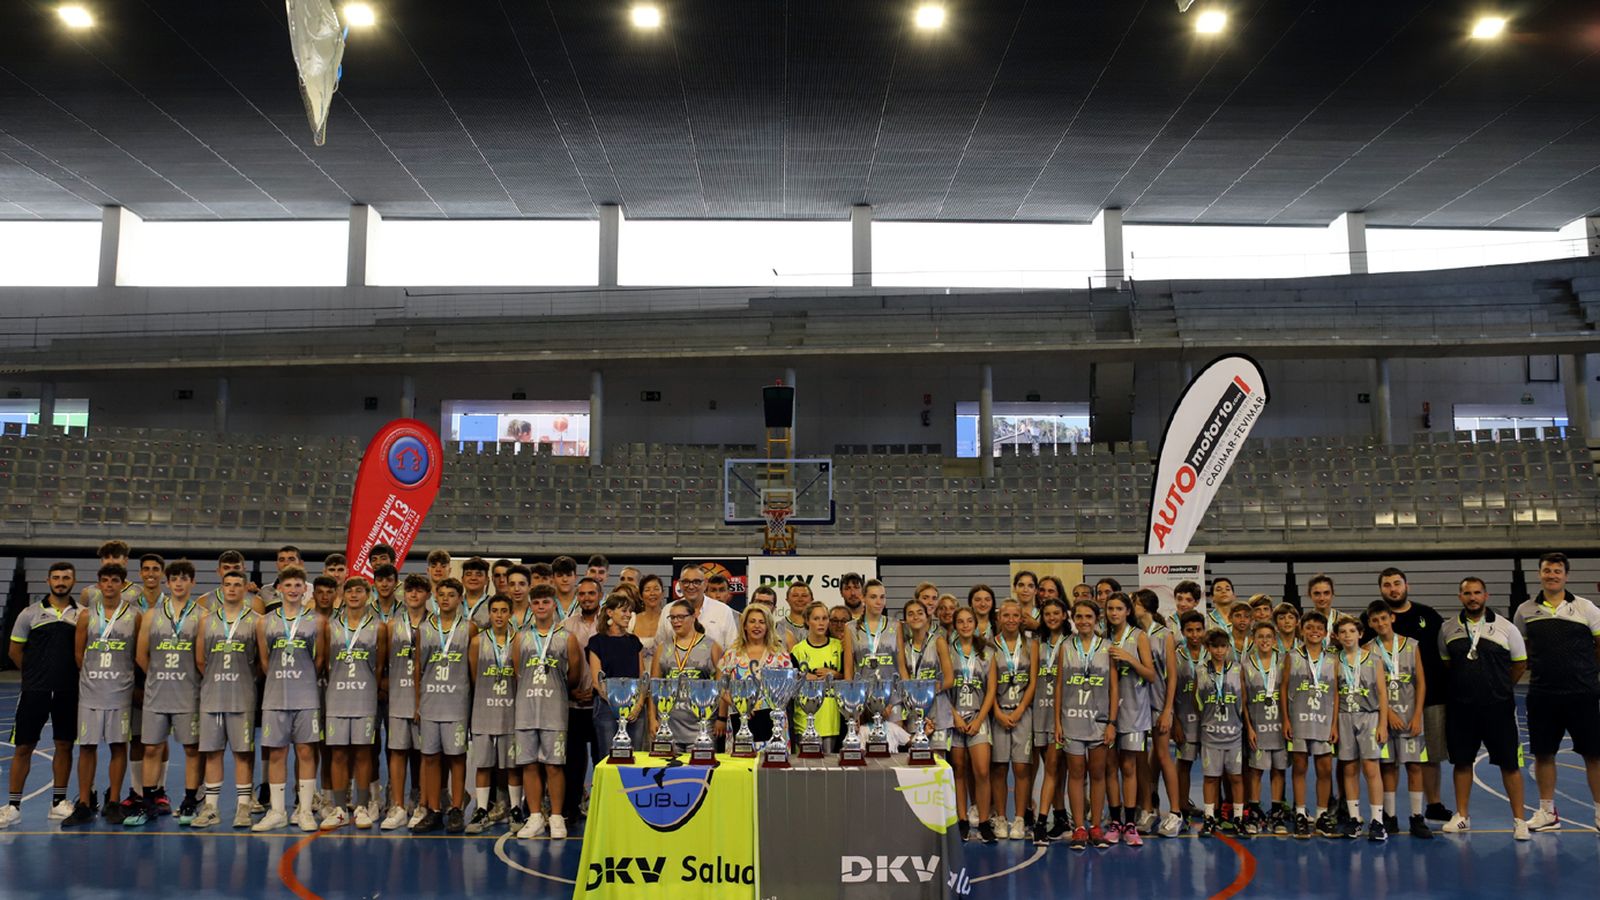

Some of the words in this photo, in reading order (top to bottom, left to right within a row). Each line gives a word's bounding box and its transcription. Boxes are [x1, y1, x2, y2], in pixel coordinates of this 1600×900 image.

[1206, 396, 1264, 486] CADIMAR-FEVIMAR
[390, 500, 410, 521] 13
[1153, 466, 1196, 549] AUTO
[353, 541, 372, 571] GESTIÓN
[368, 493, 396, 543] INMOBILIARIA
[1144, 565, 1168, 574] AUTO
[760, 575, 814, 588] DKV
[165, 653, 179, 668] 32
[223, 654, 231, 669] 2
[88, 671, 120, 680] DKV
[156, 672, 187, 681] DKV
[214, 673, 240, 681] DKV
[275, 670, 302, 679] DKV
[348, 664, 356, 677] 2
[435, 666, 449, 680] 30
[336, 681, 367, 690] DKV
[426, 684, 456, 693] DKV
[493, 680, 507, 695] 42
[526, 688, 554, 698] DKV
[959, 693, 973, 706] 20
[1078, 689, 1091, 705] 17
[486, 698, 514, 707] DKV
[1067, 709, 1098, 718] DKV
[1264, 705, 1278, 720] 39
[1299, 713, 1327, 723] DKV
[1206, 725, 1236, 733] DKV
[635, 793, 690, 808] UBJ
[585, 857, 666, 891] DKV
[840, 854, 940, 883] DKV
